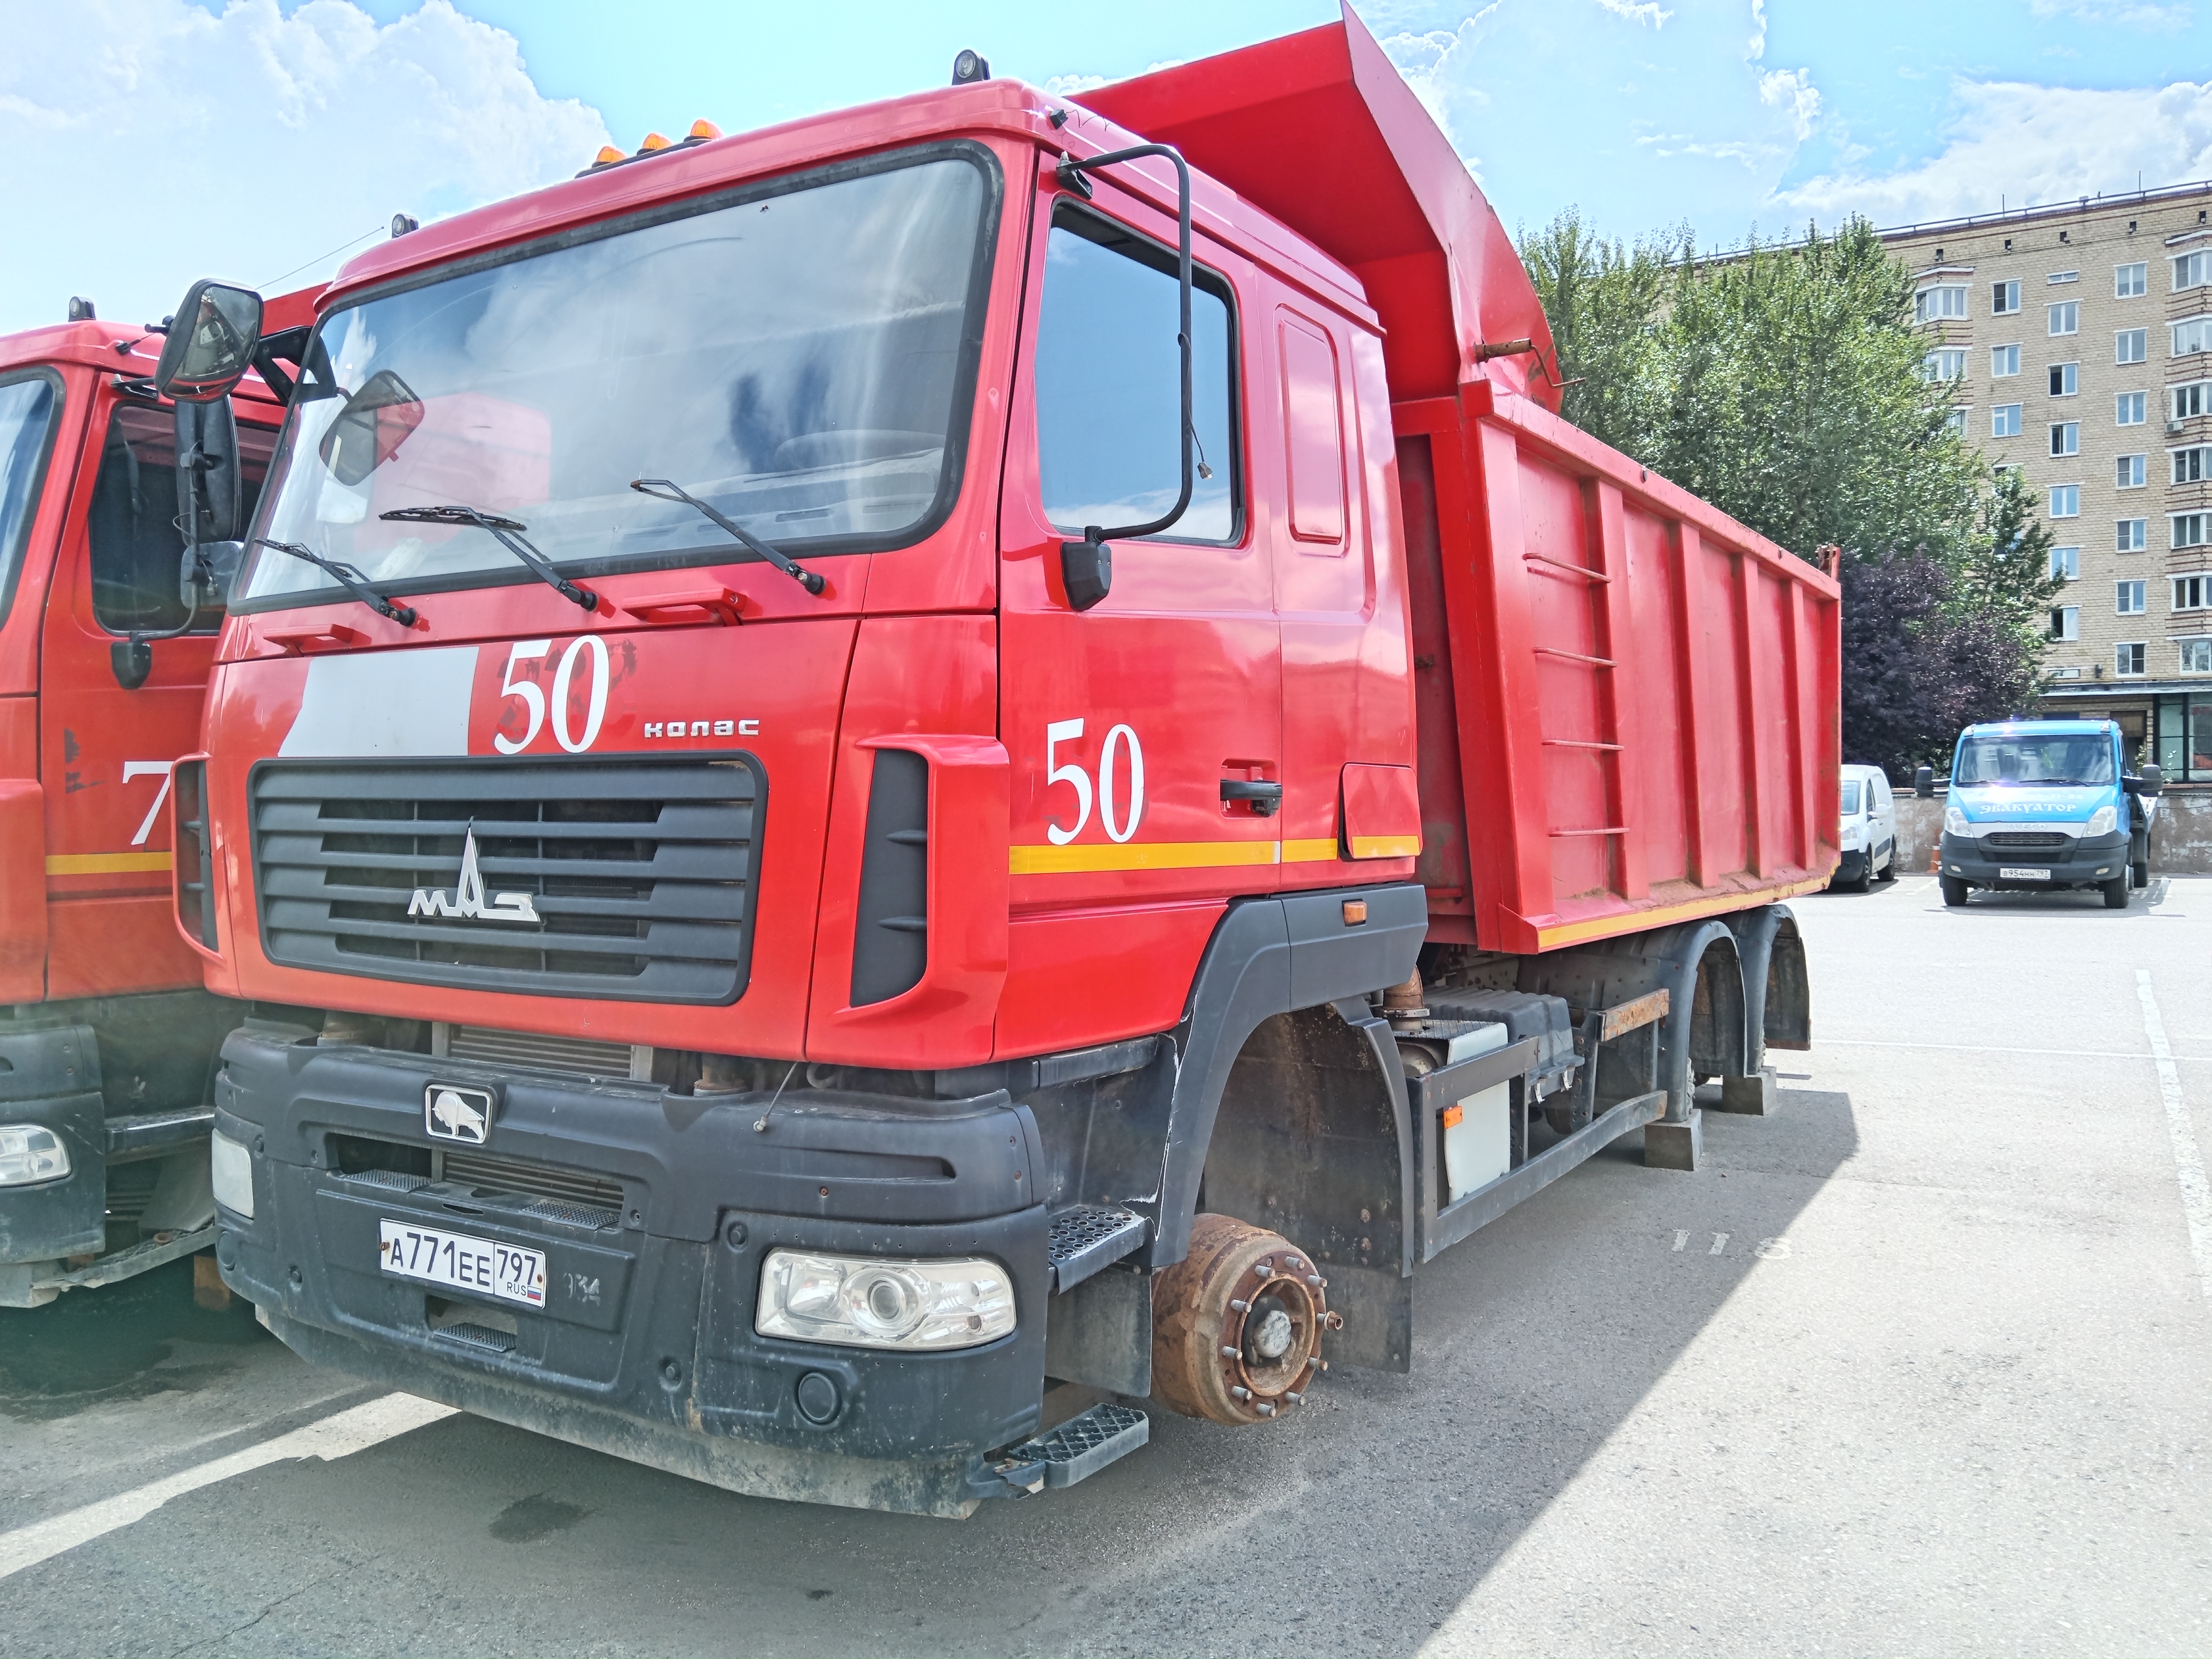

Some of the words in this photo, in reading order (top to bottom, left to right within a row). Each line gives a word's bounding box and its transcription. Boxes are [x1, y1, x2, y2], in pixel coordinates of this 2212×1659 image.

[493, 635, 610, 755] 50
[1047, 718, 1145, 846] 50
[497, 1248, 537, 1285] 797
[507, 1281, 527, 1296] RUS
